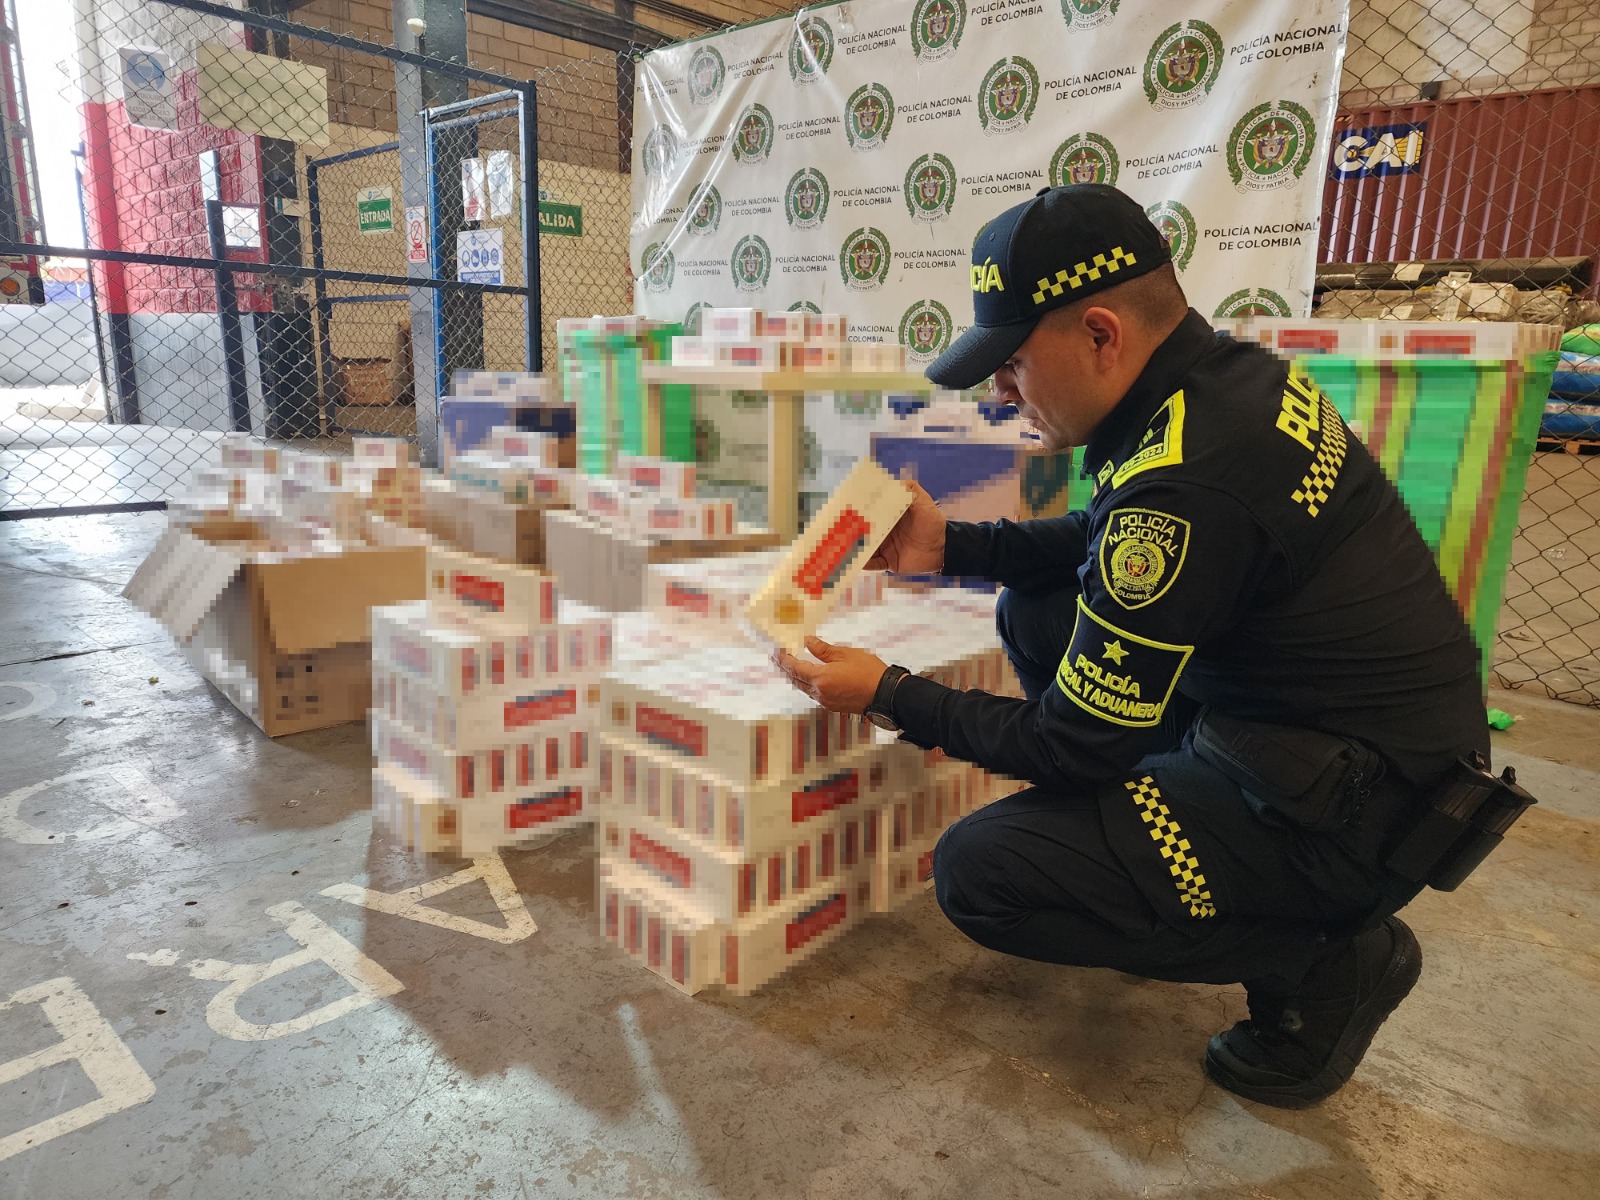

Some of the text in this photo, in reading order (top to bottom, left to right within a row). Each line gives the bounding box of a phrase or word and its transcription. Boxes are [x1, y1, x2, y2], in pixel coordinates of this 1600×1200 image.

[971, 0, 1006, 16] POLICÍA
[981, 6, 1043, 26] DE COLOMBIA
[838, 25, 907, 45] POLICÍA NACIONAL
[1230, 23, 1343, 56] POLICÍA NACIONAL
[846, 38, 896, 55] DE COLOMBIA
[1240, 41, 1325, 66] DE COLOMBIA
[1044, 66, 1137, 90] POLICÍA NACIONAL
[1056, 82, 1122, 100] DE COLOMBIA
[897, 94, 973, 113] POLICÍA NACIONAL
[778, 116, 841, 131] POLICÍA NACIONAL
[907, 109, 961, 123] DE COLOMBIA
[796, 128, 831, 139] COLOMBIA
[1237, 116, 1263, 155] REPUBLICA
[1286, 113, 1304, 149] COLOMBIA
[1126, 144, 1219, 168] POLICÍA NACIONAL
[1333, 128, 1423, 171] CAI
[1137, 160, 1203, 179] DE COLOMBIA
[1240, 154, 1301, 181] POLICIA NACIONAL
[961, 170, 1043, 185] POLICÍA NACIONAL
[833, 184, 901, 197] POLICÍA NACIONAL
[971, 182, 1031, 196] DE COLOMBIA
[725, 196, 780, 208] POLICÍA NACIONAL
[842, 197, 892, 207] DE COLOMBIA
[360, 210, 390, 224] ENTRADA
[740, 207, 772, 215] COLOMBIA
[539, 211, 576, 228] ALIDA
[1204, 222, 1318, 238] POLICÍA NACIONAL
[1219, 237, 1302, 251] DE COLOMBIA
[775, 254, 835, 264] POLICÍA NACIONAL
[894, 248, 967, 259] POLICÍA NACIONAL
[677, 260, 698, 268] POLICÍA
[792, 264, 827, 272] COLOMBIA
[915, 260, 956, 268] COLOMBIA
[692, 268, 721, 276] COLOMBIA
[857, 325, 894, 333] NACIONAL
[848, 335, 884, 343] COLOMBIA
[1120, 514, 1176, 538] POLICÍA
[1108, 527, 1179, 557] NACIONAL
[1114, 587, 1151, 600] COLOMBIA
[1075, 653, 1141, 698] POLICÍA
[1083, 682, 1094, 698] Y
[1089, 688, 1161, 718] ADUANERA
